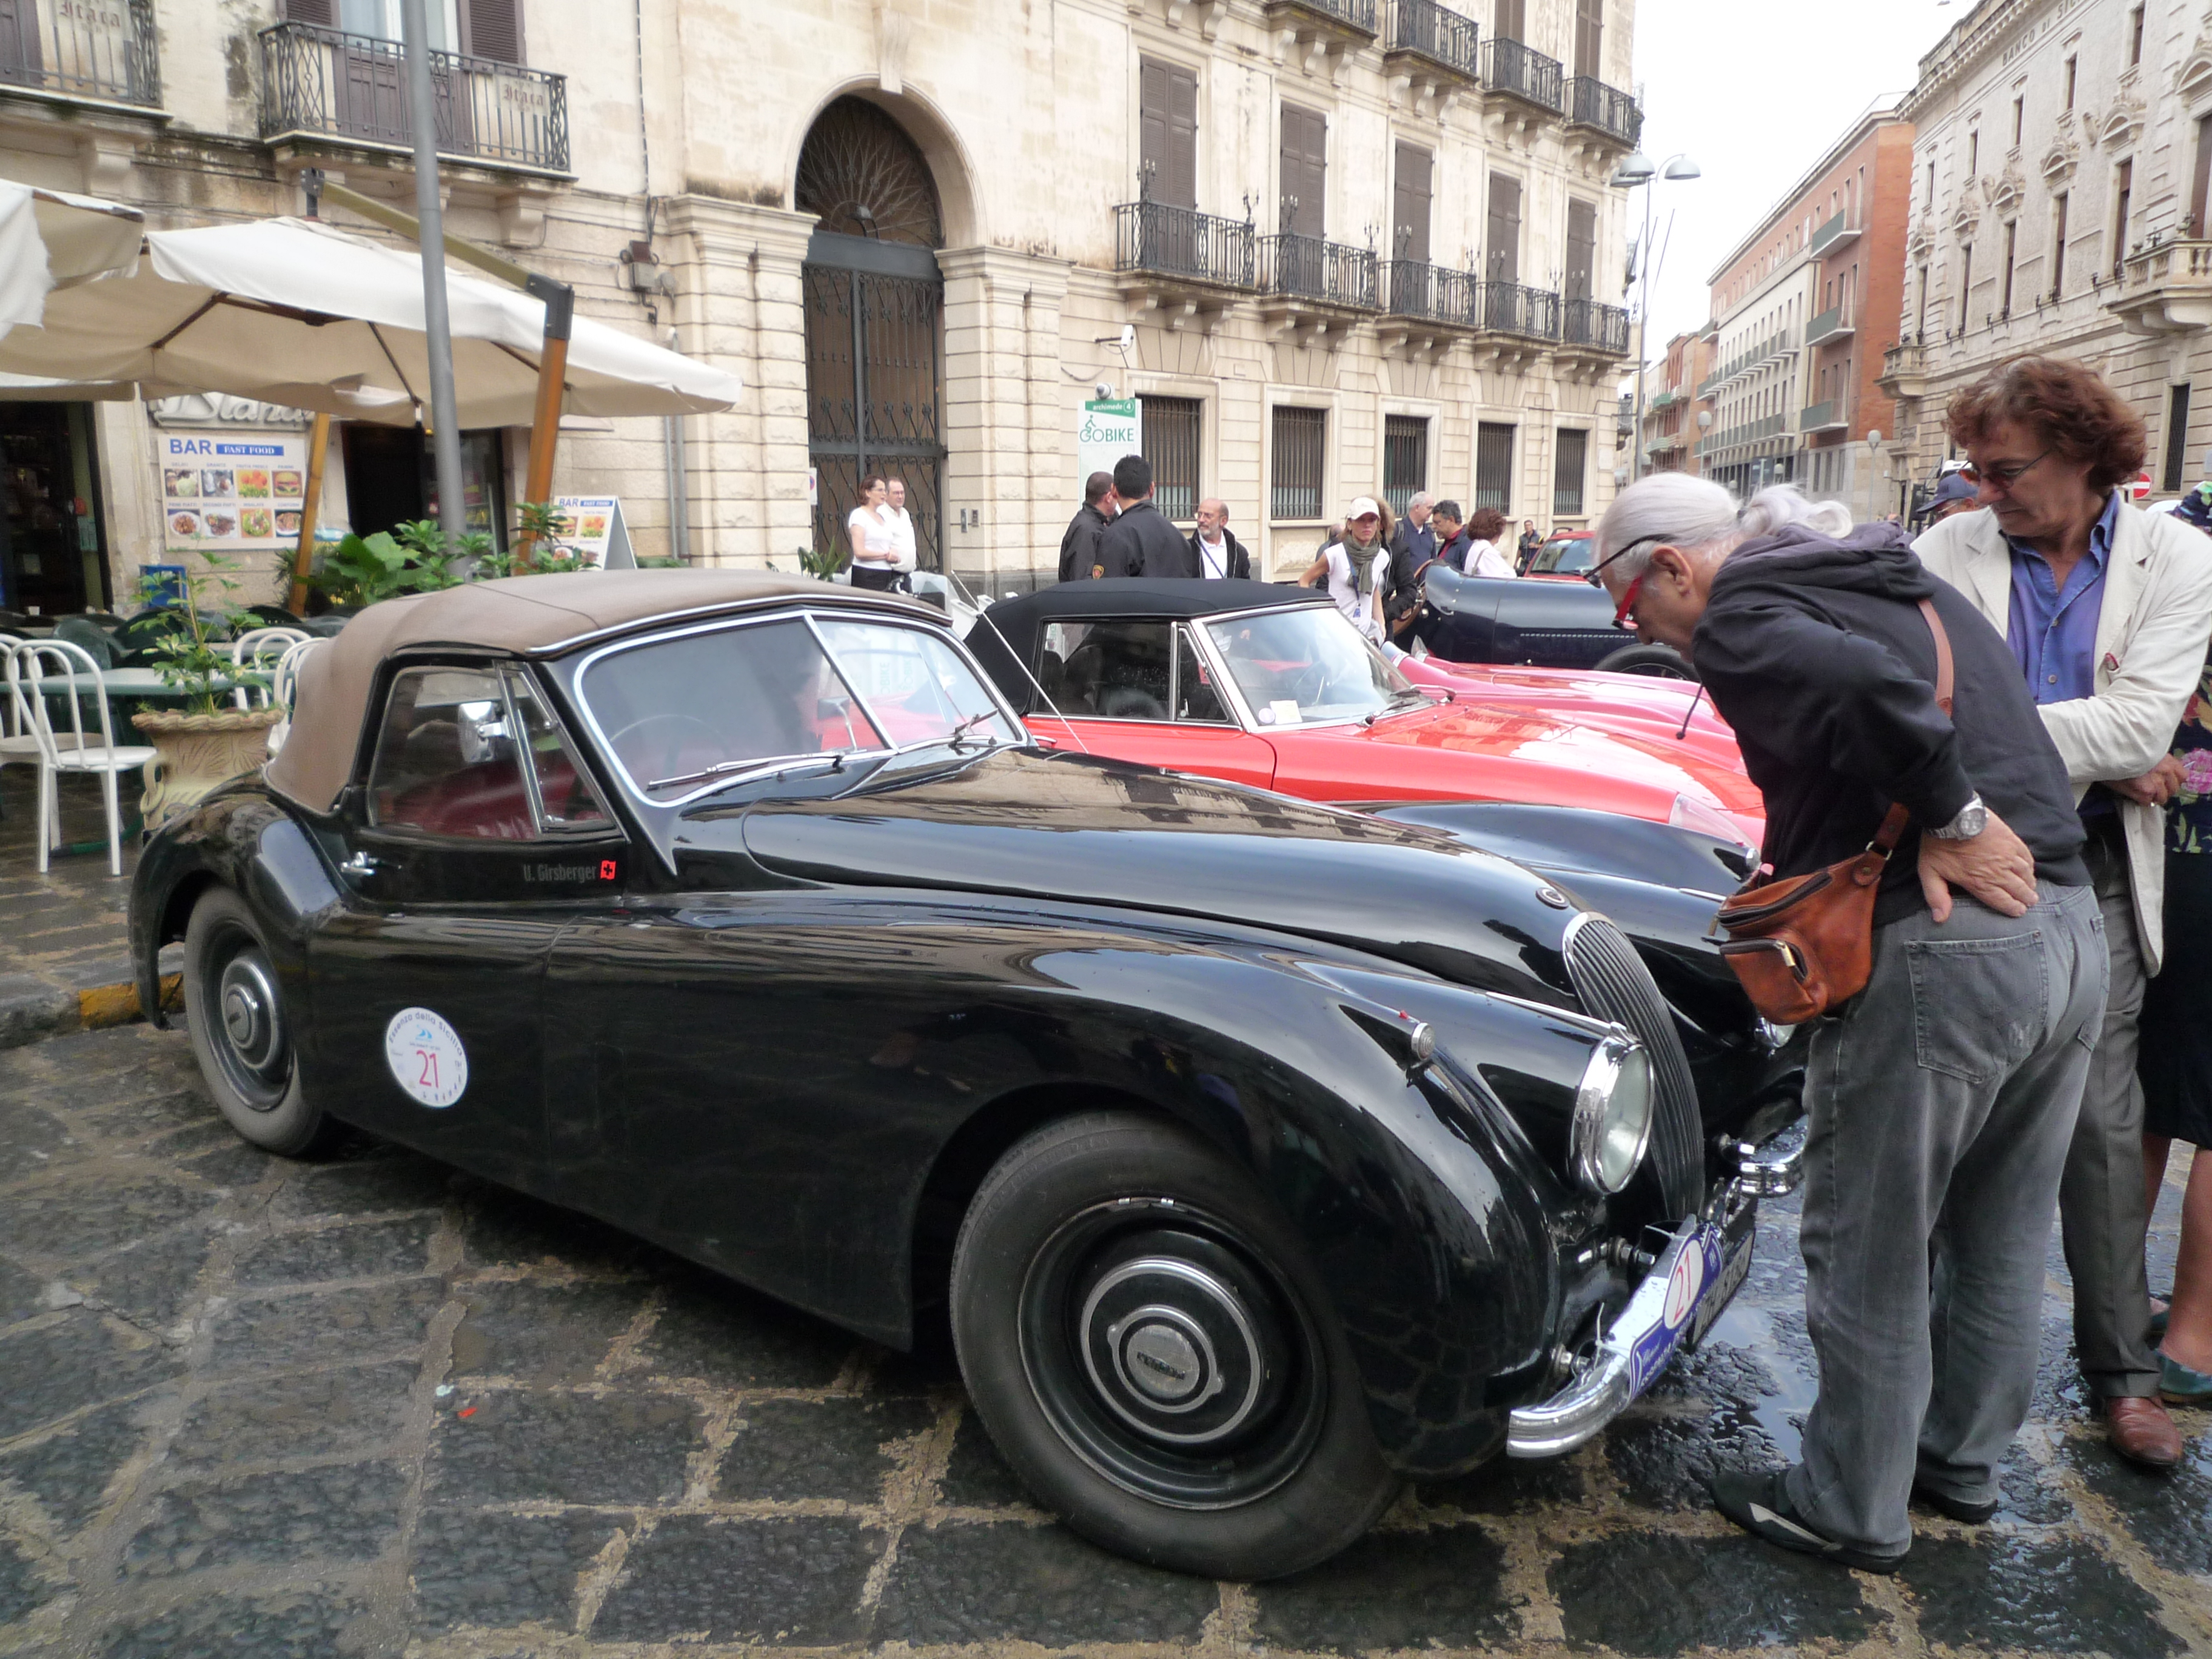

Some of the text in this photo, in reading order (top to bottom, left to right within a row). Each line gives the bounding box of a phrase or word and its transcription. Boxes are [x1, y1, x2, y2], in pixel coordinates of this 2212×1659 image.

[1093, 403, 1123, 411] archimede
[1079, 428, 1134, 443] GOBIKE
[169, 438, 212, 455] BAR
[249, 446, 275, 455] FOOD
[558, 498, 579, 508] BAR
[880, 662, 890, 694] OBIKE
[537, 863, 597, 883] Girsberger
[415, 1011, 436, 1025] della
[438, 1021, 463, 1056] Sicilia
[416, 1049, 439, 1089] 21
[1673, 1248, 1691, 1323] 21
